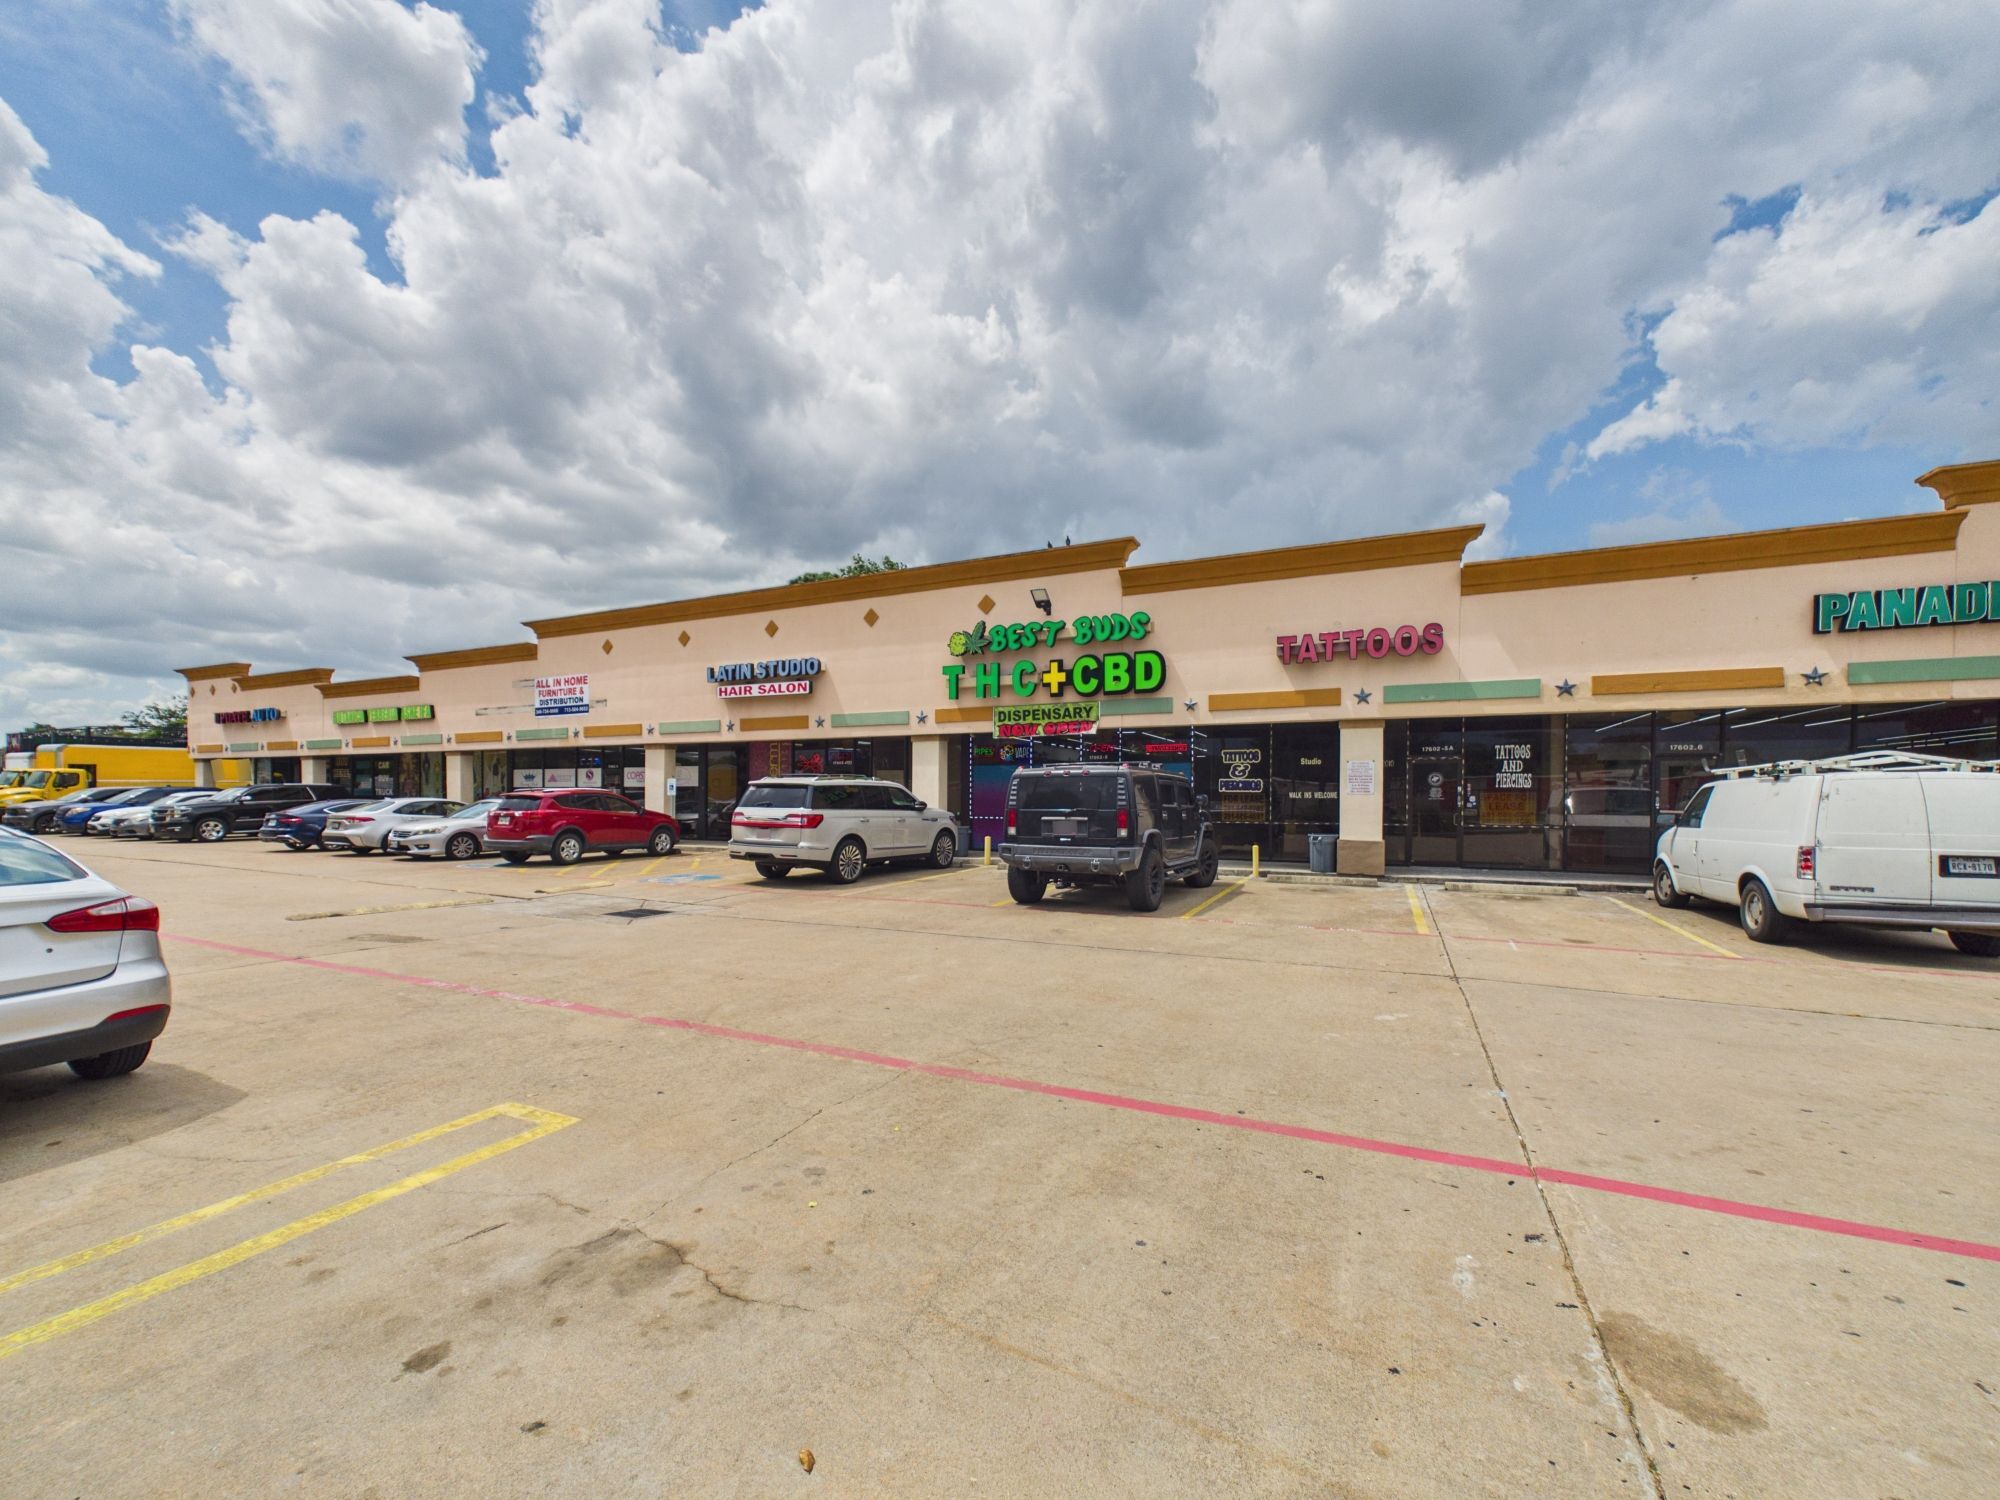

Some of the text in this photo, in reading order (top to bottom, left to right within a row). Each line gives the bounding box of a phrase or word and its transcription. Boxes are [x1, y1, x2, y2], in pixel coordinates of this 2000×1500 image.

[988, 611, 1151, 652] BEST BUDS
[1276, 622, 1444, 665] TATTOOS
[707, 657, 821, 683] LATIN STUDIO
[535, 675, 588, 688] ALL IN HOME
[538, 686, 584, 698] FURNITURE &
[718, 682, 808, 697] HAIR SALON
[539, 696, 584, 706] DISTRIBUTION
[251, 707, 281, 722] AUTO
[997, 706, 1093, 723] DISPENSARY
[999, 721, 1094, 738] NOW OPEN
[1222, 749, 1260, 763] TATTOOS
[1495, 744, 1531, 759] TATTOOS
[1300, 757, 1322, 765] Studio
[1501, 760, 1524, 772] AND
[1495, 773, 1532, 788] PIERCINGS
